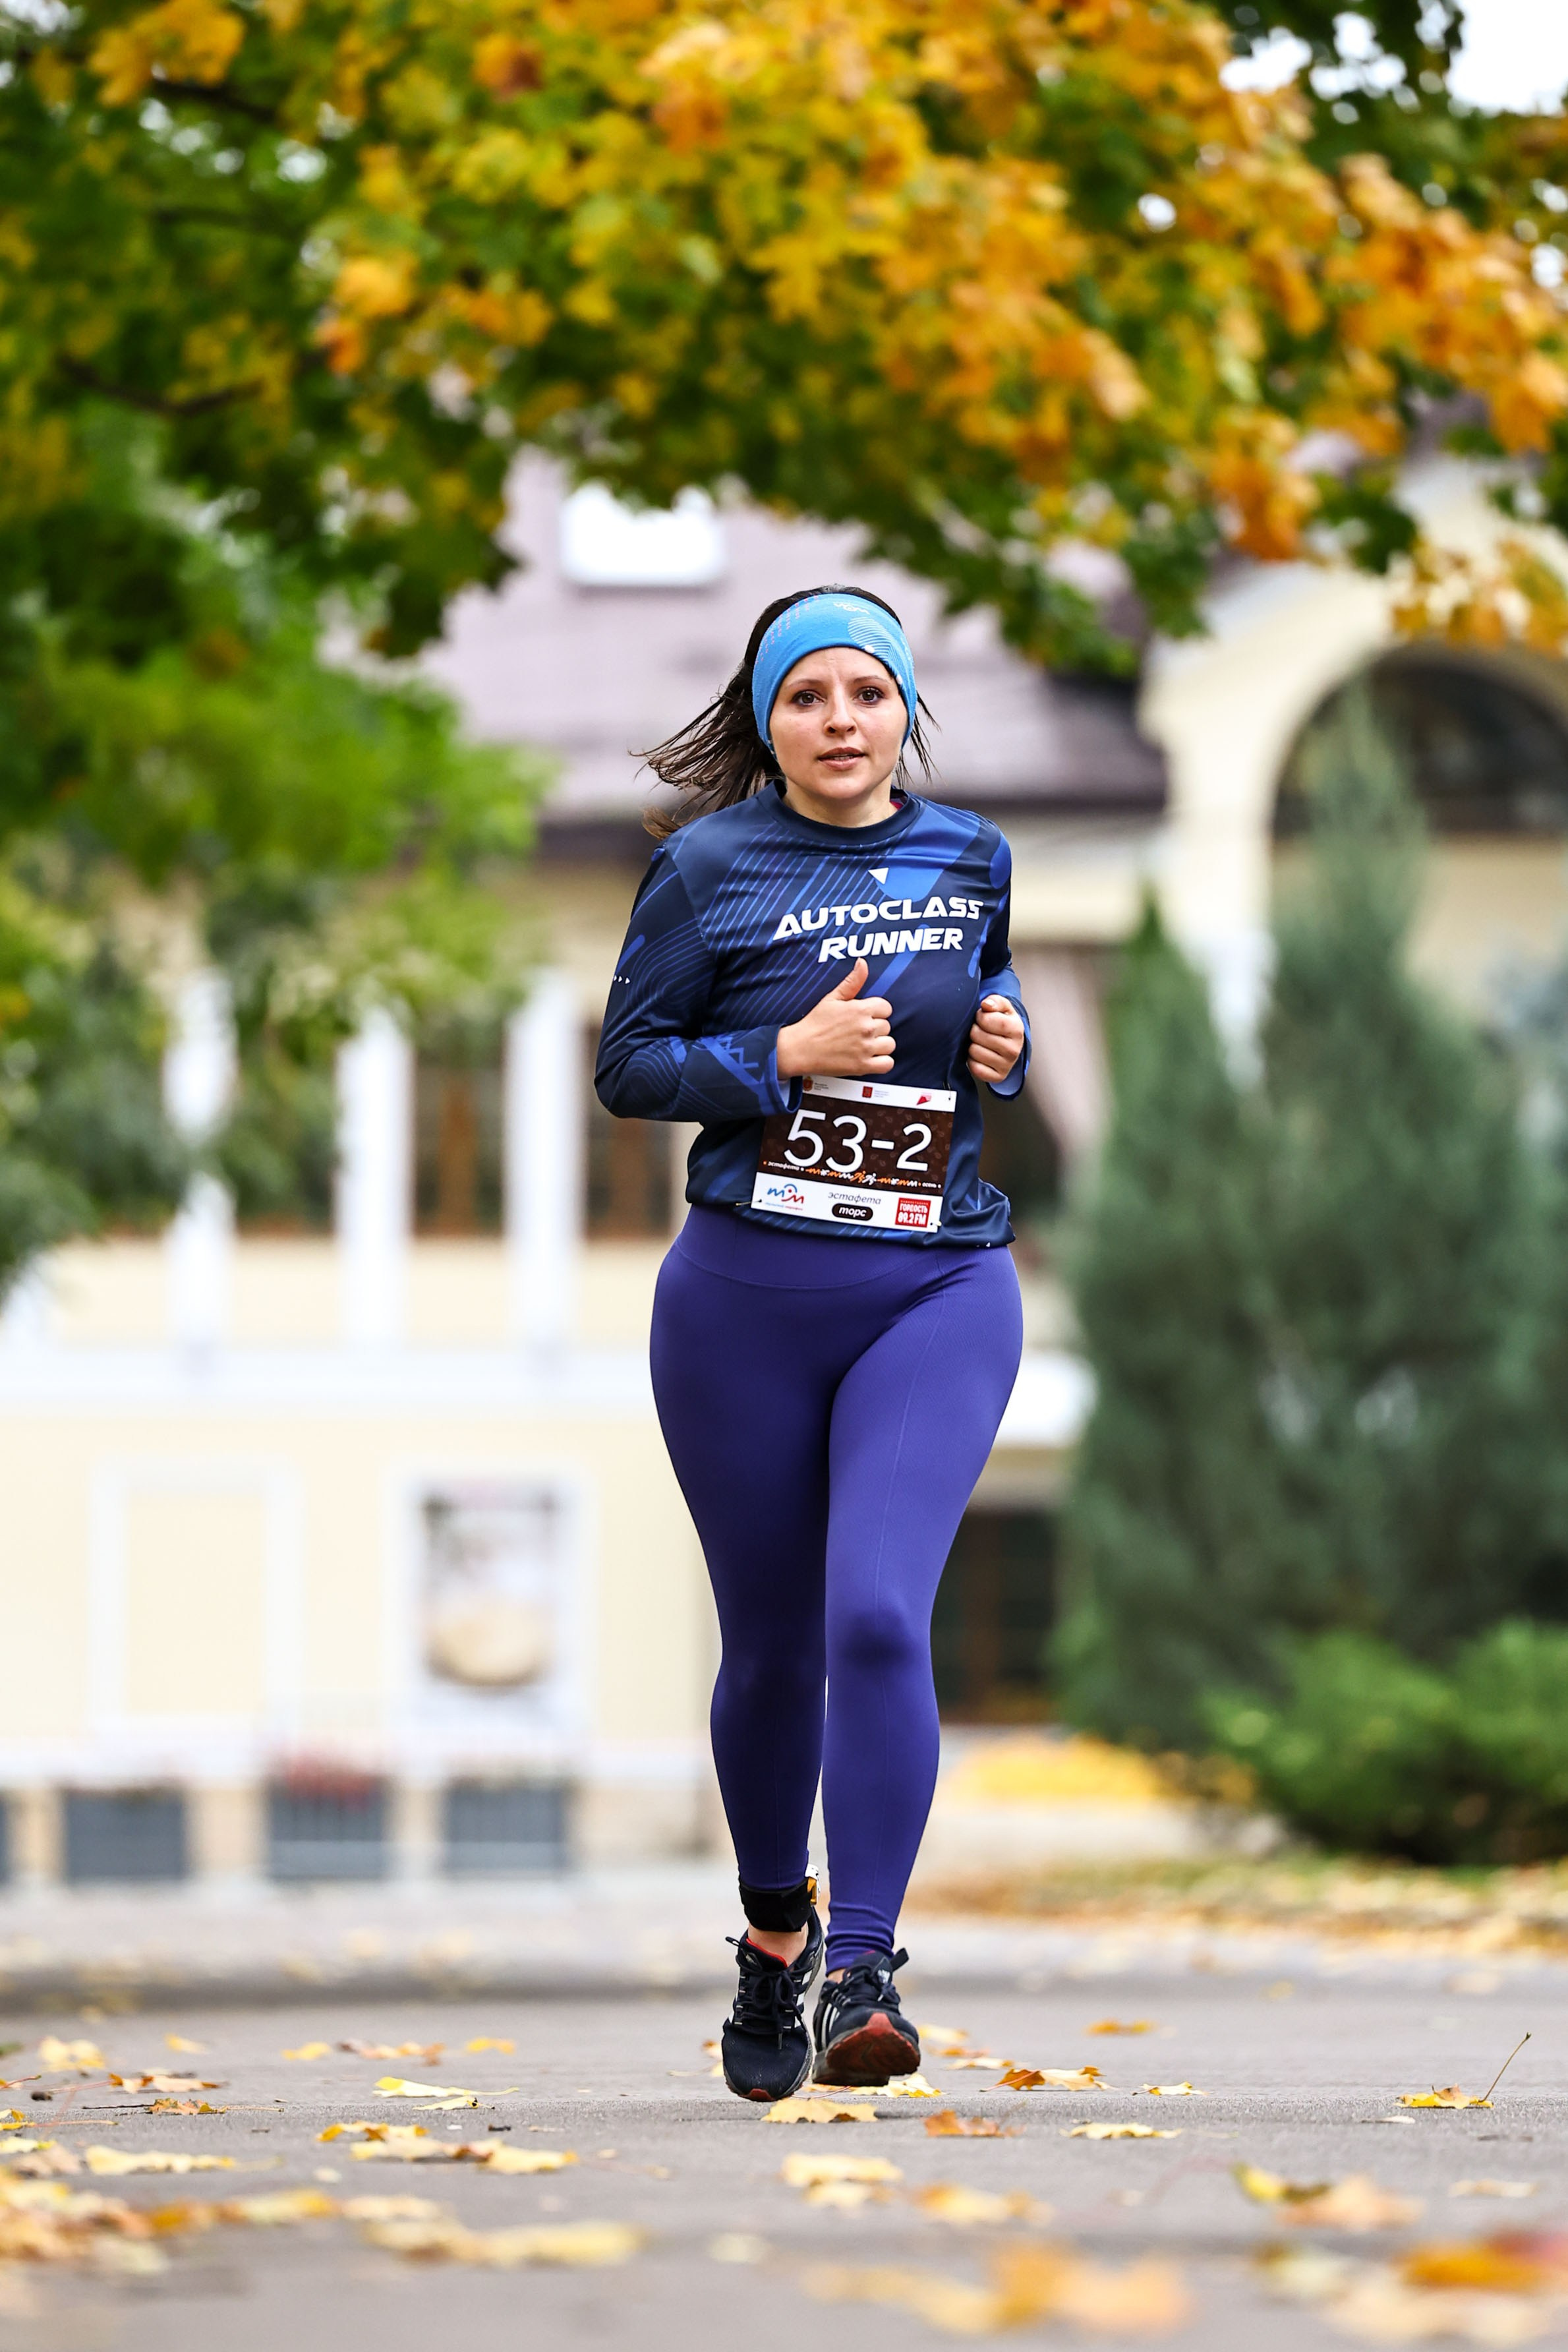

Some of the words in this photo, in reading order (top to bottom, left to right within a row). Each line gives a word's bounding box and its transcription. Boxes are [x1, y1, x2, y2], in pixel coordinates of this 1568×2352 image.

[772, 896, 984, 941] AUTOCLASS
[817, 927, 964, 963] RUNNER
[784, 1109, 932, 1173] 53-2
[827, 1191, 882, 1205] эстафета
